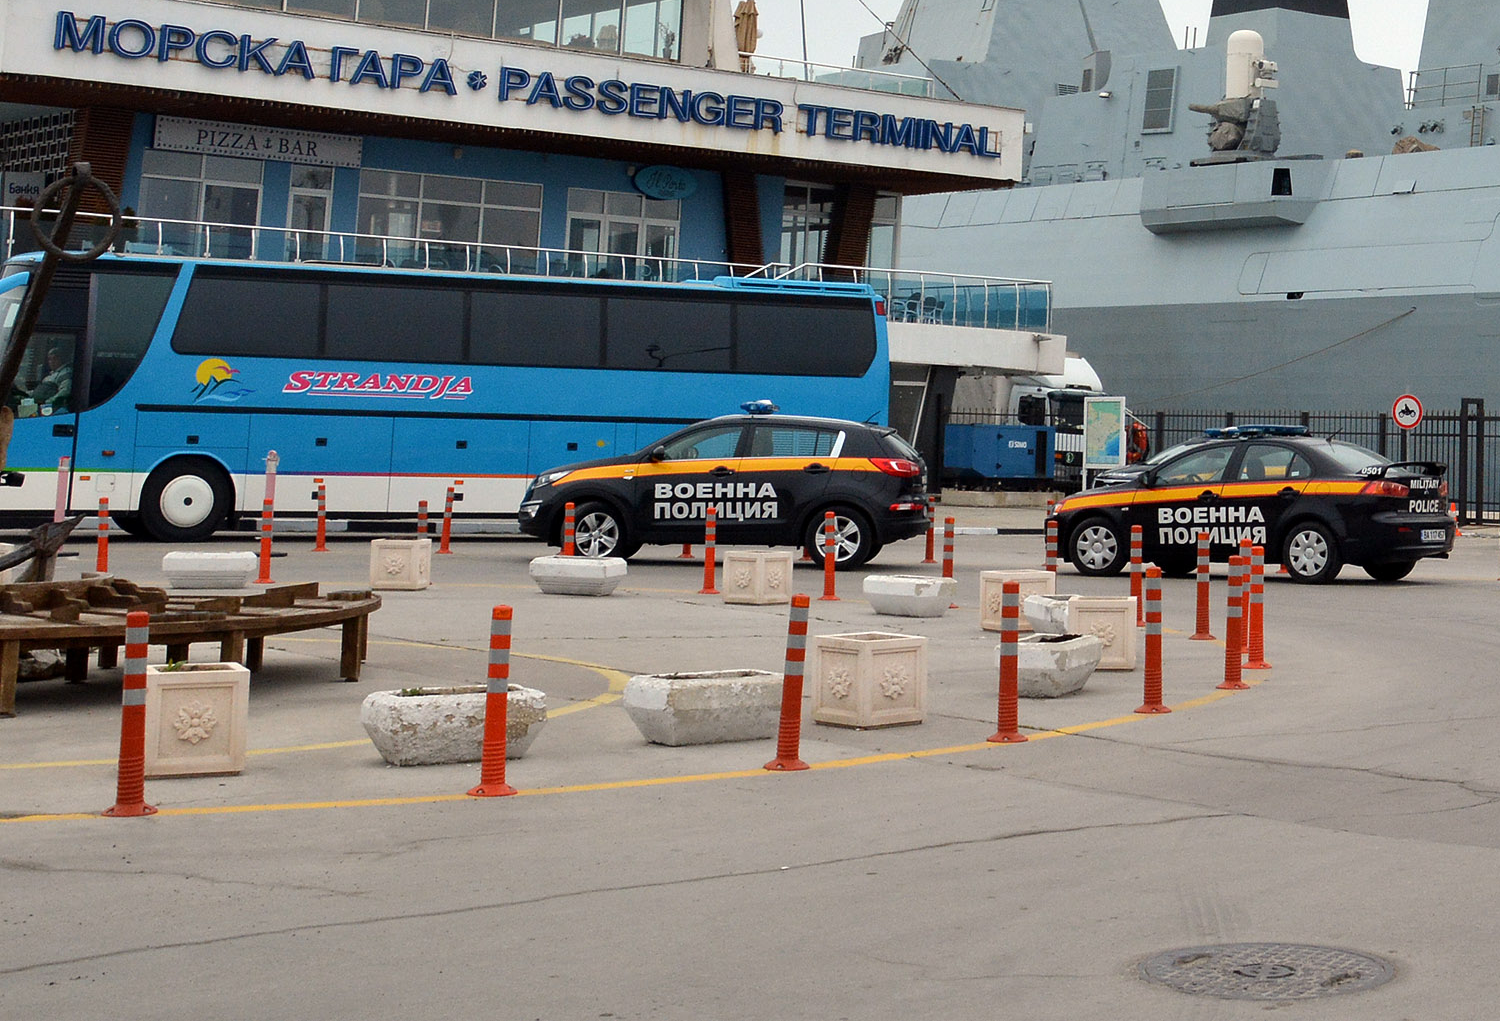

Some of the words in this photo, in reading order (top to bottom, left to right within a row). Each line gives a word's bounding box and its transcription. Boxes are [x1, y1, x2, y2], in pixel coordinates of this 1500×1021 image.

[53, 10, 316, 80] МОРСКА
[329, 45, 458, 97] ГАРА
[499, 65, 784, 134] PASSENGER
[796, 102, 1001, 159] TERMINAL
[197, 130, 258, 151] PIZZA
[278, 137, 318, 157] BAR
[282, 370, 475, 400] STRANDJA
[1361, 467, 1383, 475] 0501
[654, 482, 778, 499] ВОЕННА
[1410, 479, 1440, 489] MILITARY
[654, 501, 779, 522] ПОЛИЦИЯ
[1157, 506, 1266, 524] ВОЕННА
[1408, 500, 1440, 513] POLICE
[1158, 526, 1268, 547] ПОЛИЦИЯ
